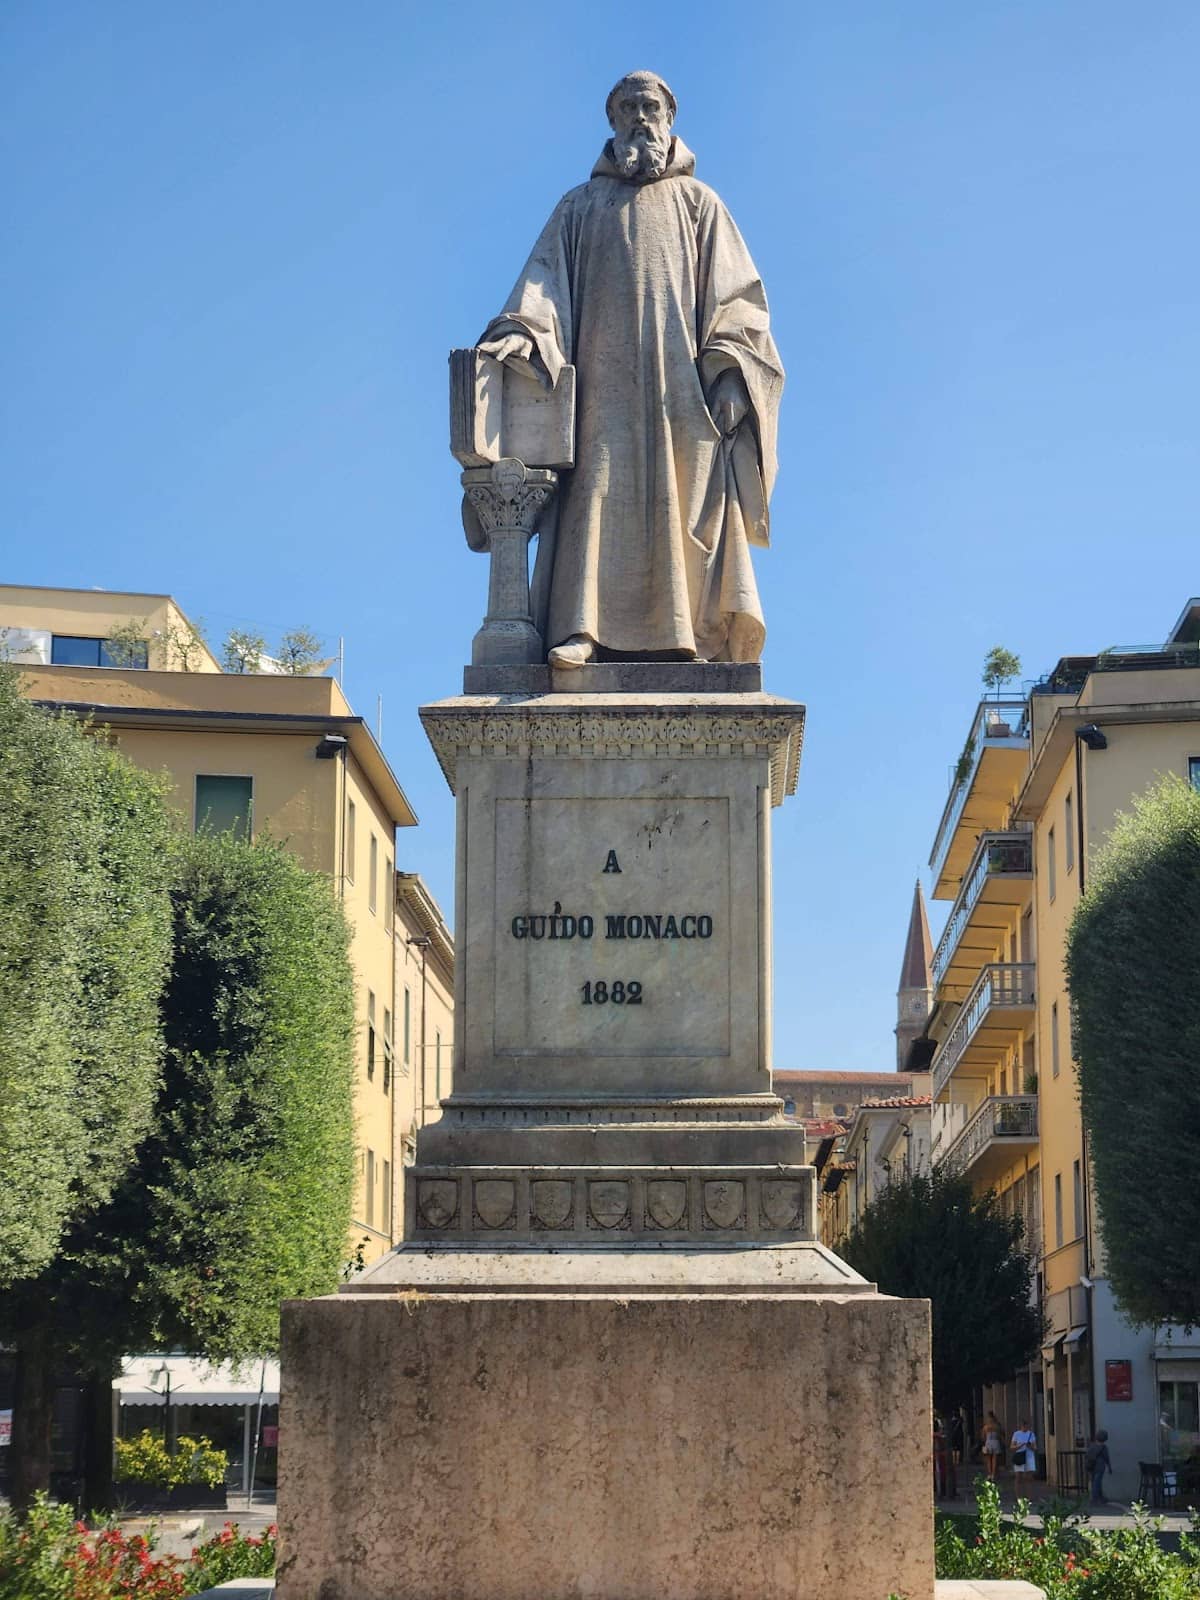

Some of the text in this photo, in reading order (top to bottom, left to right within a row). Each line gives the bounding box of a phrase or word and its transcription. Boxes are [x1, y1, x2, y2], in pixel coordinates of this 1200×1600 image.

[602, 849, 622, 874] A
[511, 914, 713, 940] GUIDO MONACO
[581, 980, 643, 1005] 1882
